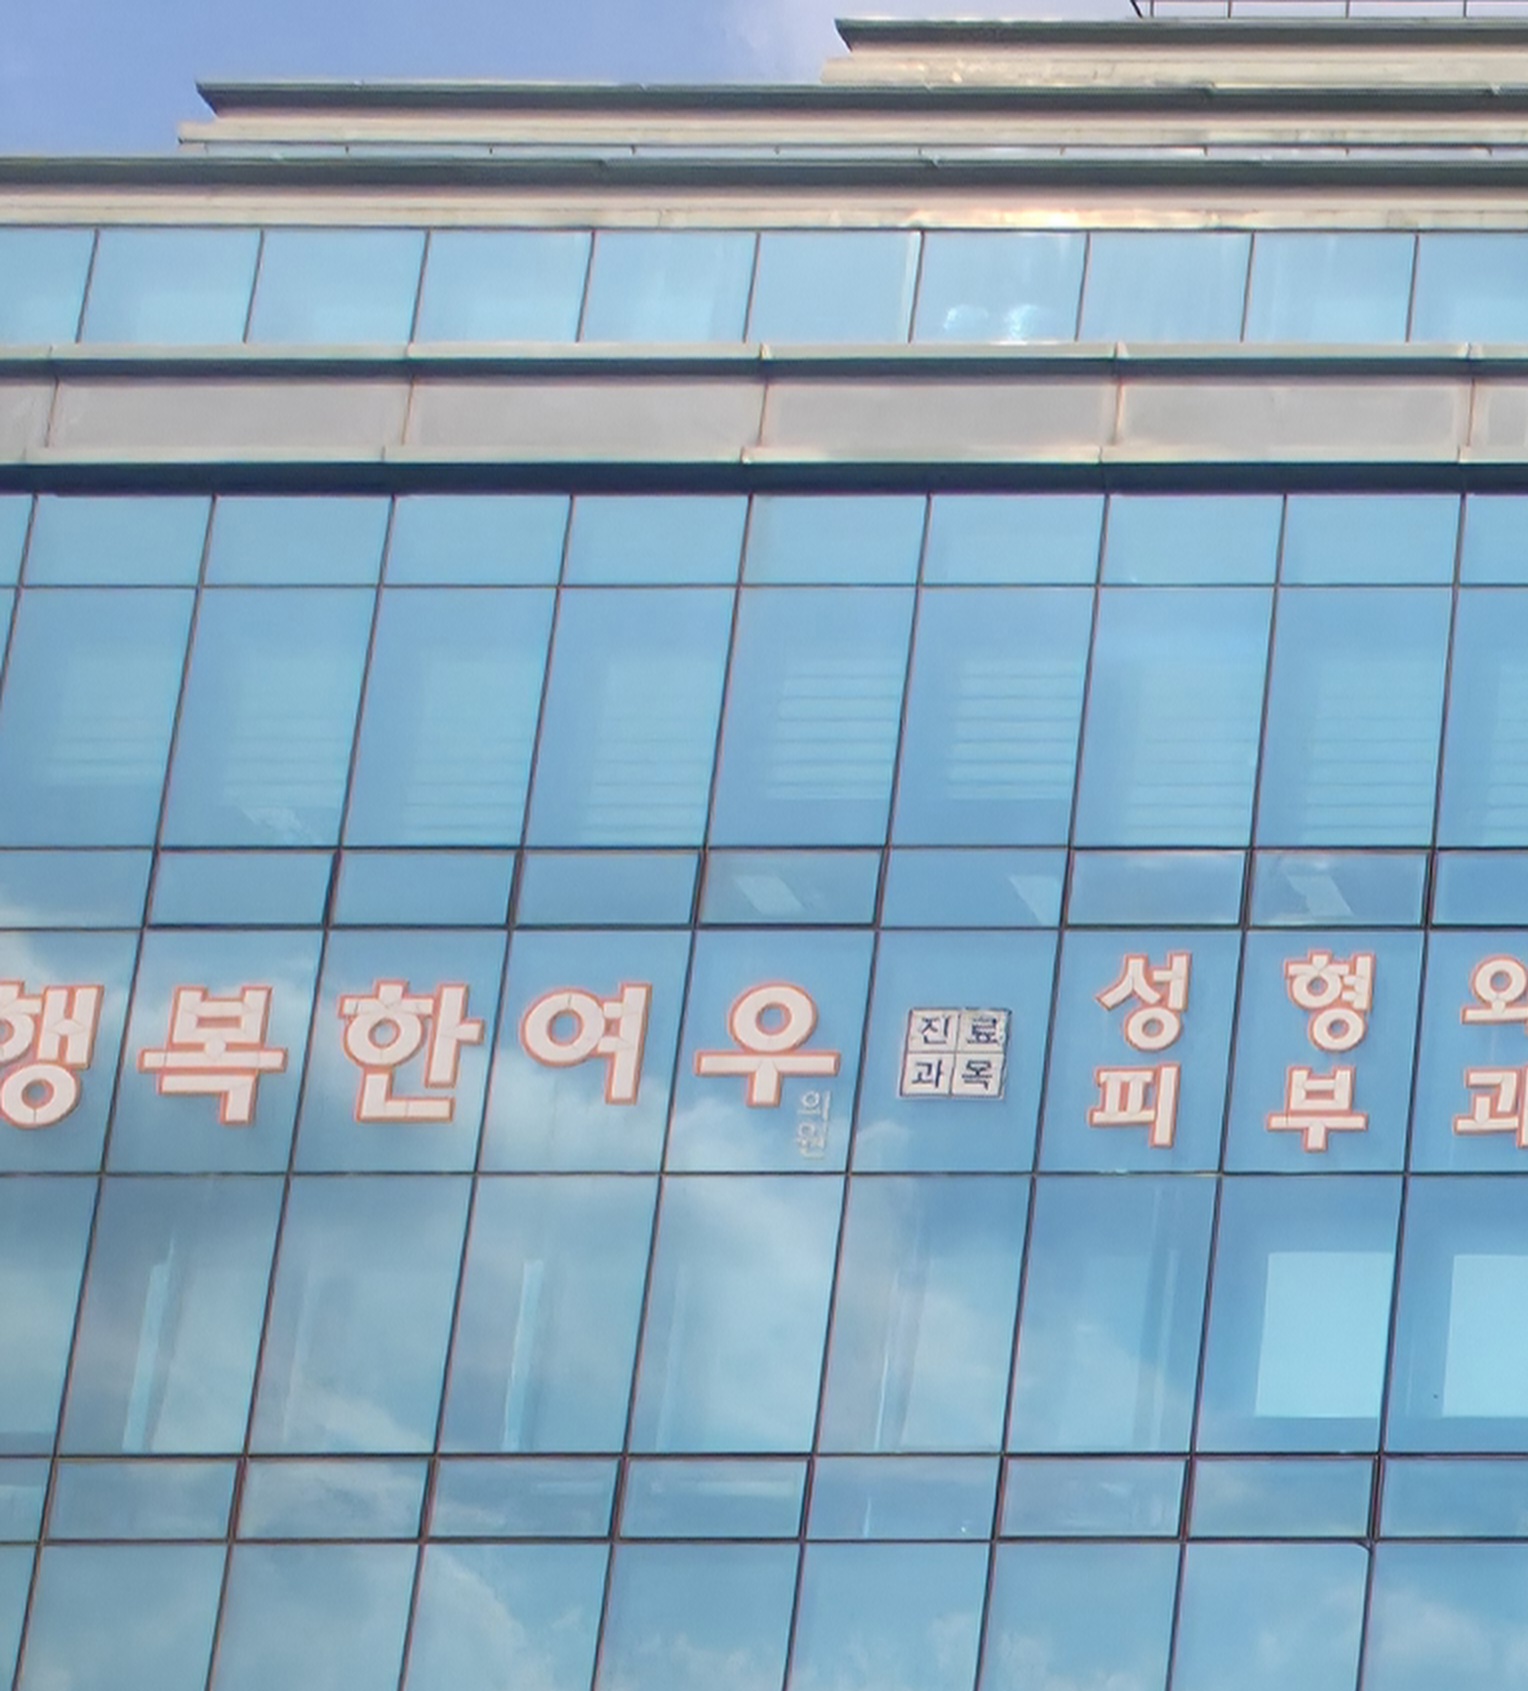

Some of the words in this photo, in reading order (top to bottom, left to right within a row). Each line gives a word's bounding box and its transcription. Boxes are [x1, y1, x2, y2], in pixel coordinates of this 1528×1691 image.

[919, 1014, 1000, 1046] 진료
[0, 977, 843, 1128] 행복한여우
[910, 1057, 993, 1091] 과목
